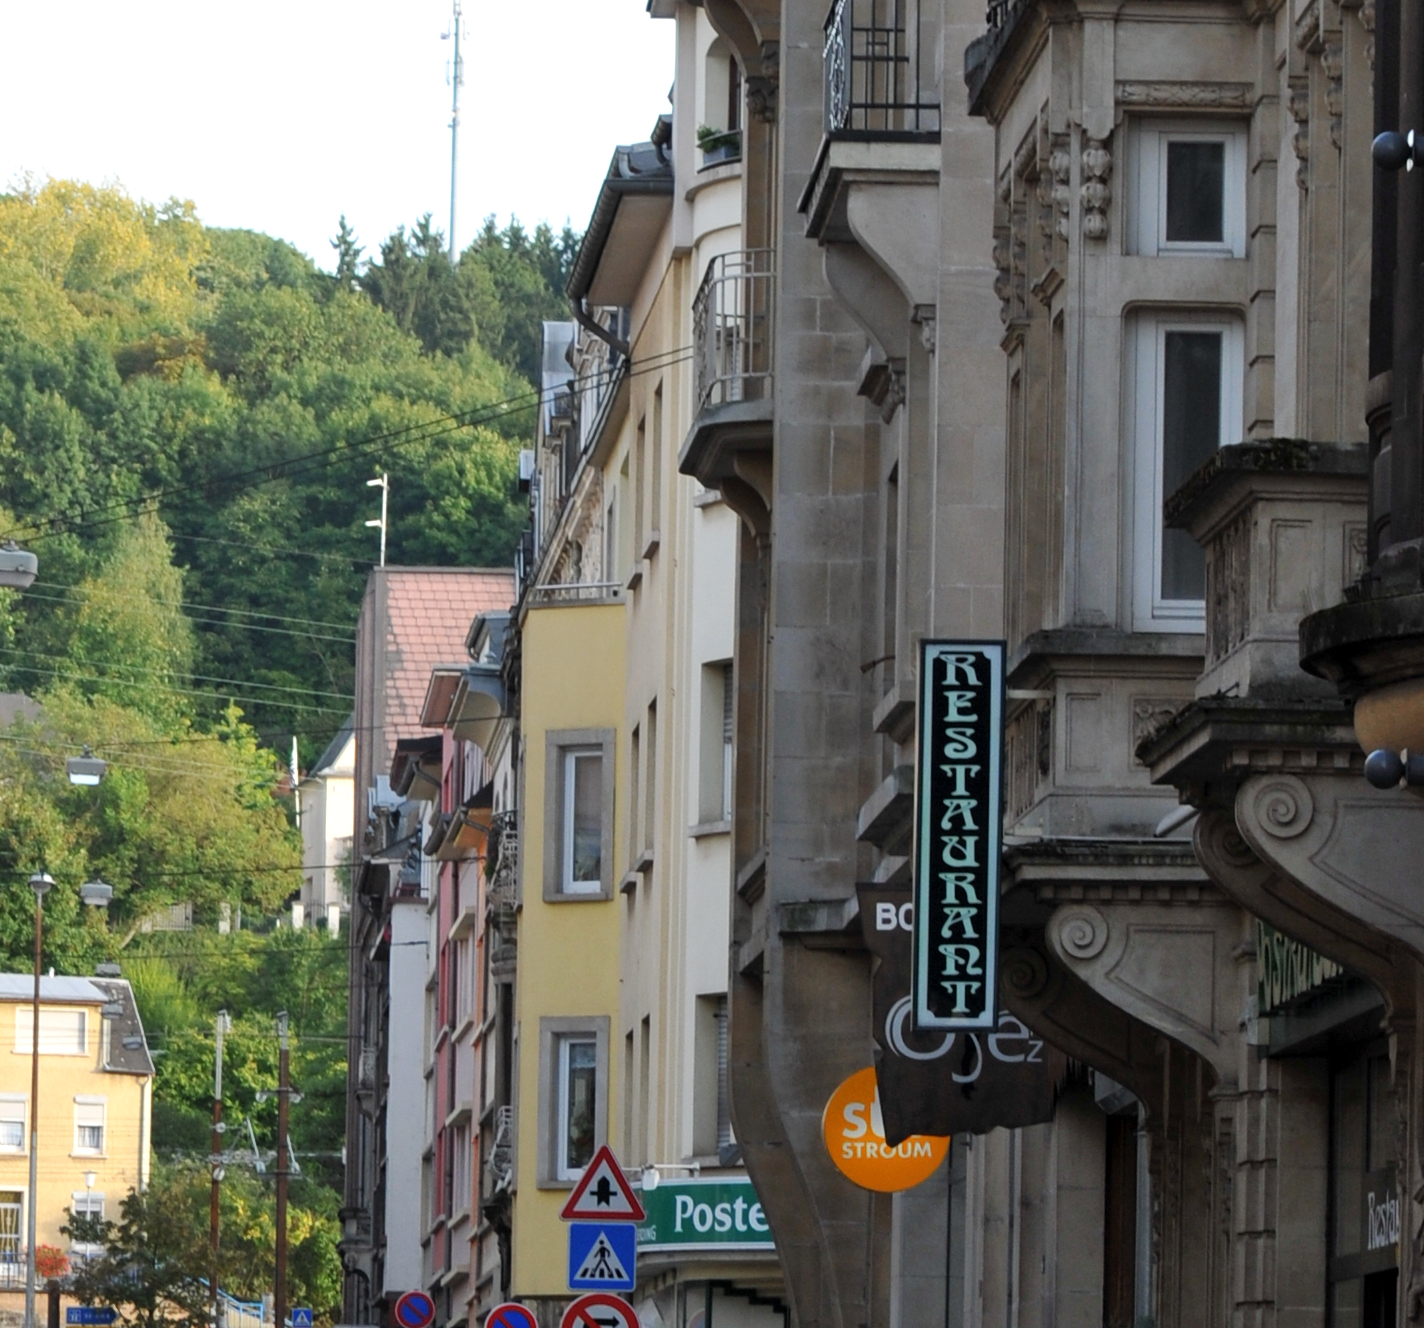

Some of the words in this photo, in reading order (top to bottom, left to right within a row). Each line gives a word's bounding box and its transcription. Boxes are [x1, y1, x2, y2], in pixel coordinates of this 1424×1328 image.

[938, 653, 983, 1013] RESTAURANT
[842, 1141, 932, 1159] STROUM
[674, 1194, 769, 1232] Poste
